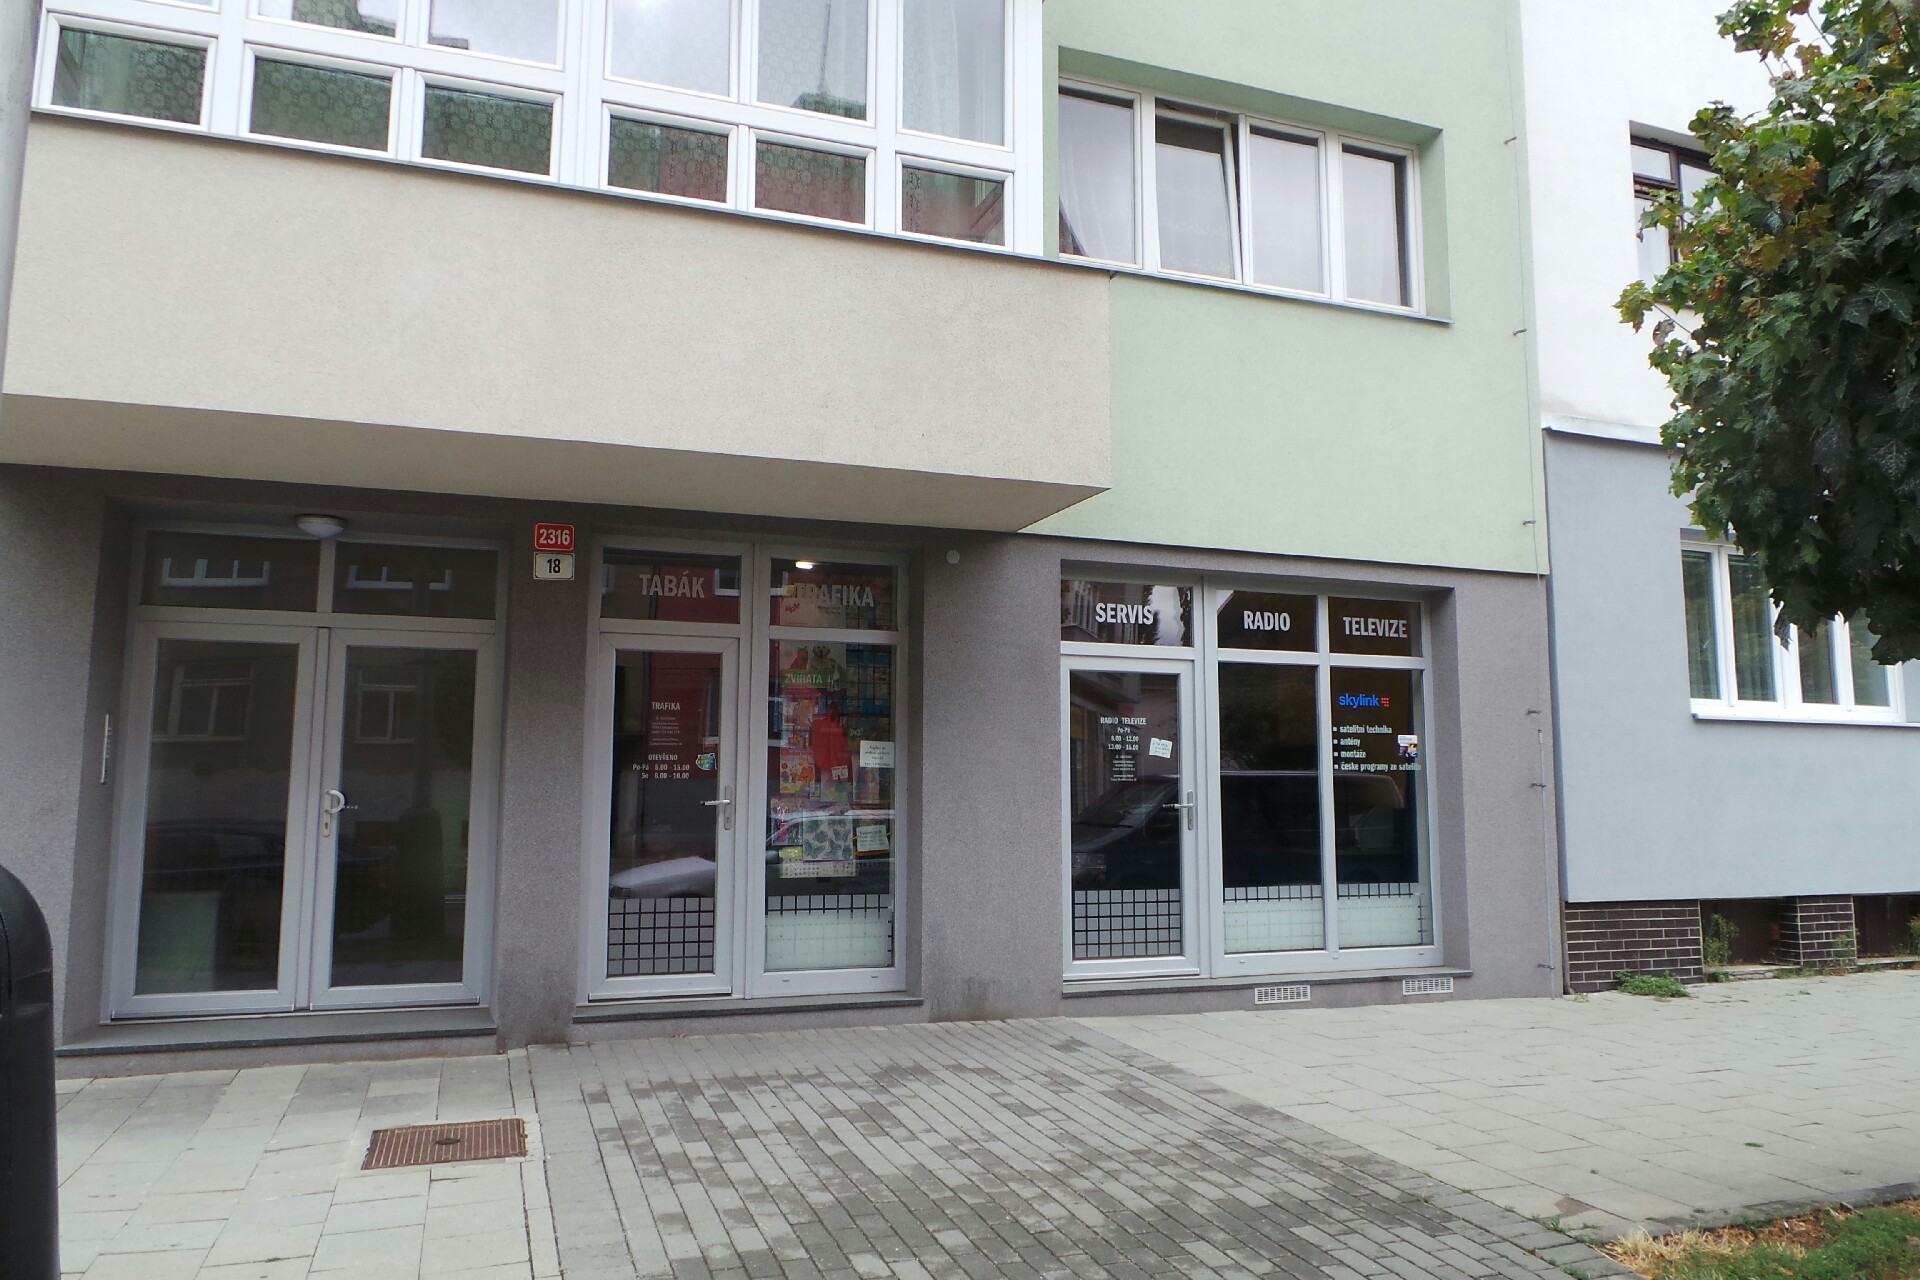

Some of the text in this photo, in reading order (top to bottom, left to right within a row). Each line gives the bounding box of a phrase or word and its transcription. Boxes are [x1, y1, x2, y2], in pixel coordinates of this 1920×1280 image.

[539, 528, 571, 545] 2316
[547, 558, 561, 574] 18
[638, 570, 705, 599] TABÁK
[794, 582, 875, 607] TRAFIKA
[1095, 602, 1154, 625] SERVIS
[1243, 610, 1291, 631] RADIO
[1342, 616, 1408, 639] TELEVIZE
[652, 702, 681, 711] TRAFIKA
[1339, 693, 1380, 709] skylink
[1100, 716, 1147, 726] RADIO TELEVIZE
[1366, 725, 1392, 733] technika
[1340, 736, 1361, 748] antény
[648, 753, 678, 761] OTEVŘENO
[1340, 749, 1366, 758] montáže
[1360, 763, 1389, 772] programy
